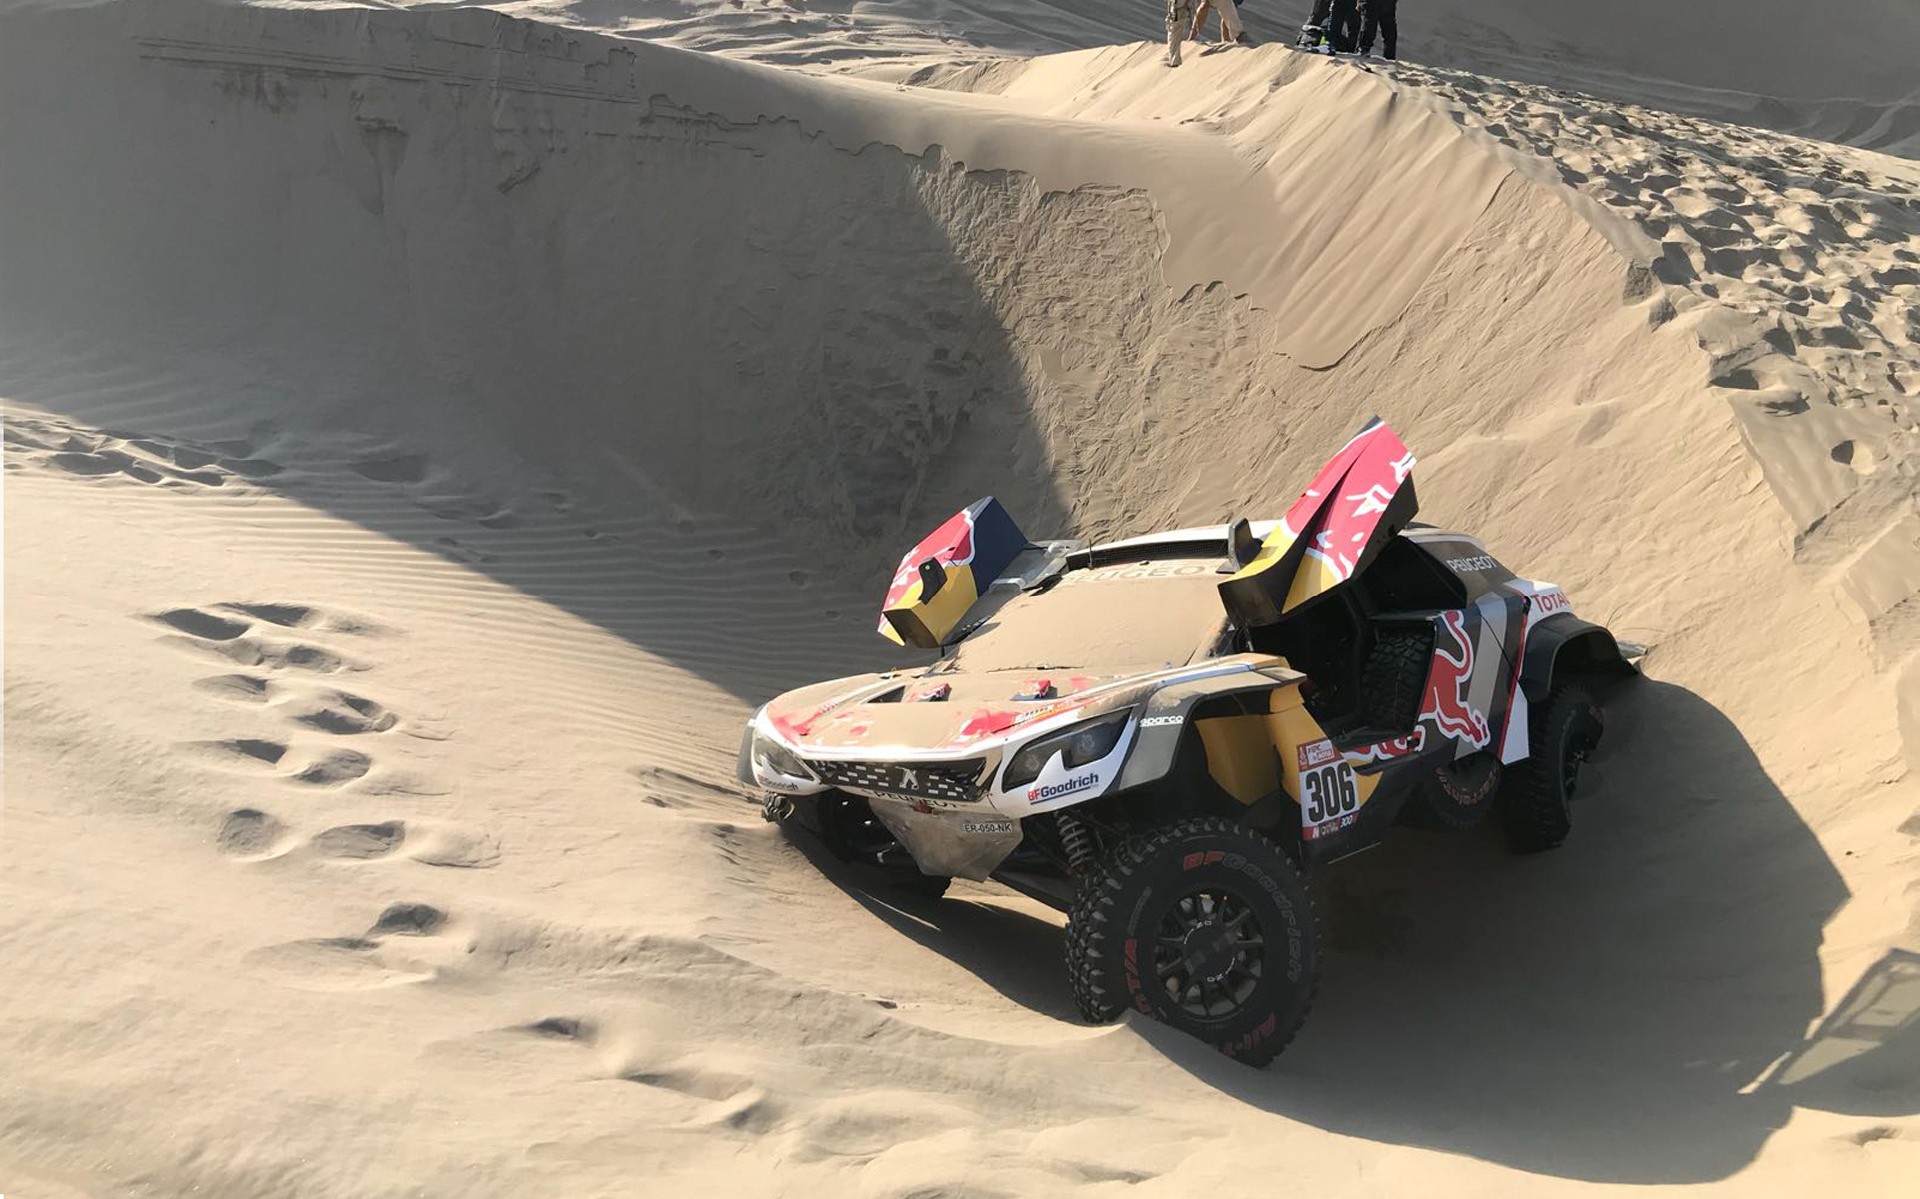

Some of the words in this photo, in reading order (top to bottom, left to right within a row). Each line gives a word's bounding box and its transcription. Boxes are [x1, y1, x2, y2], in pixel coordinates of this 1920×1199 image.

[1446, 555, 1497, 573] PEUGEOT
[1140, 715, 1184, 727] sparco
[1027, 772, 1099, 801] BFGoodrich
[1306, 761, 1355, 822] 306
